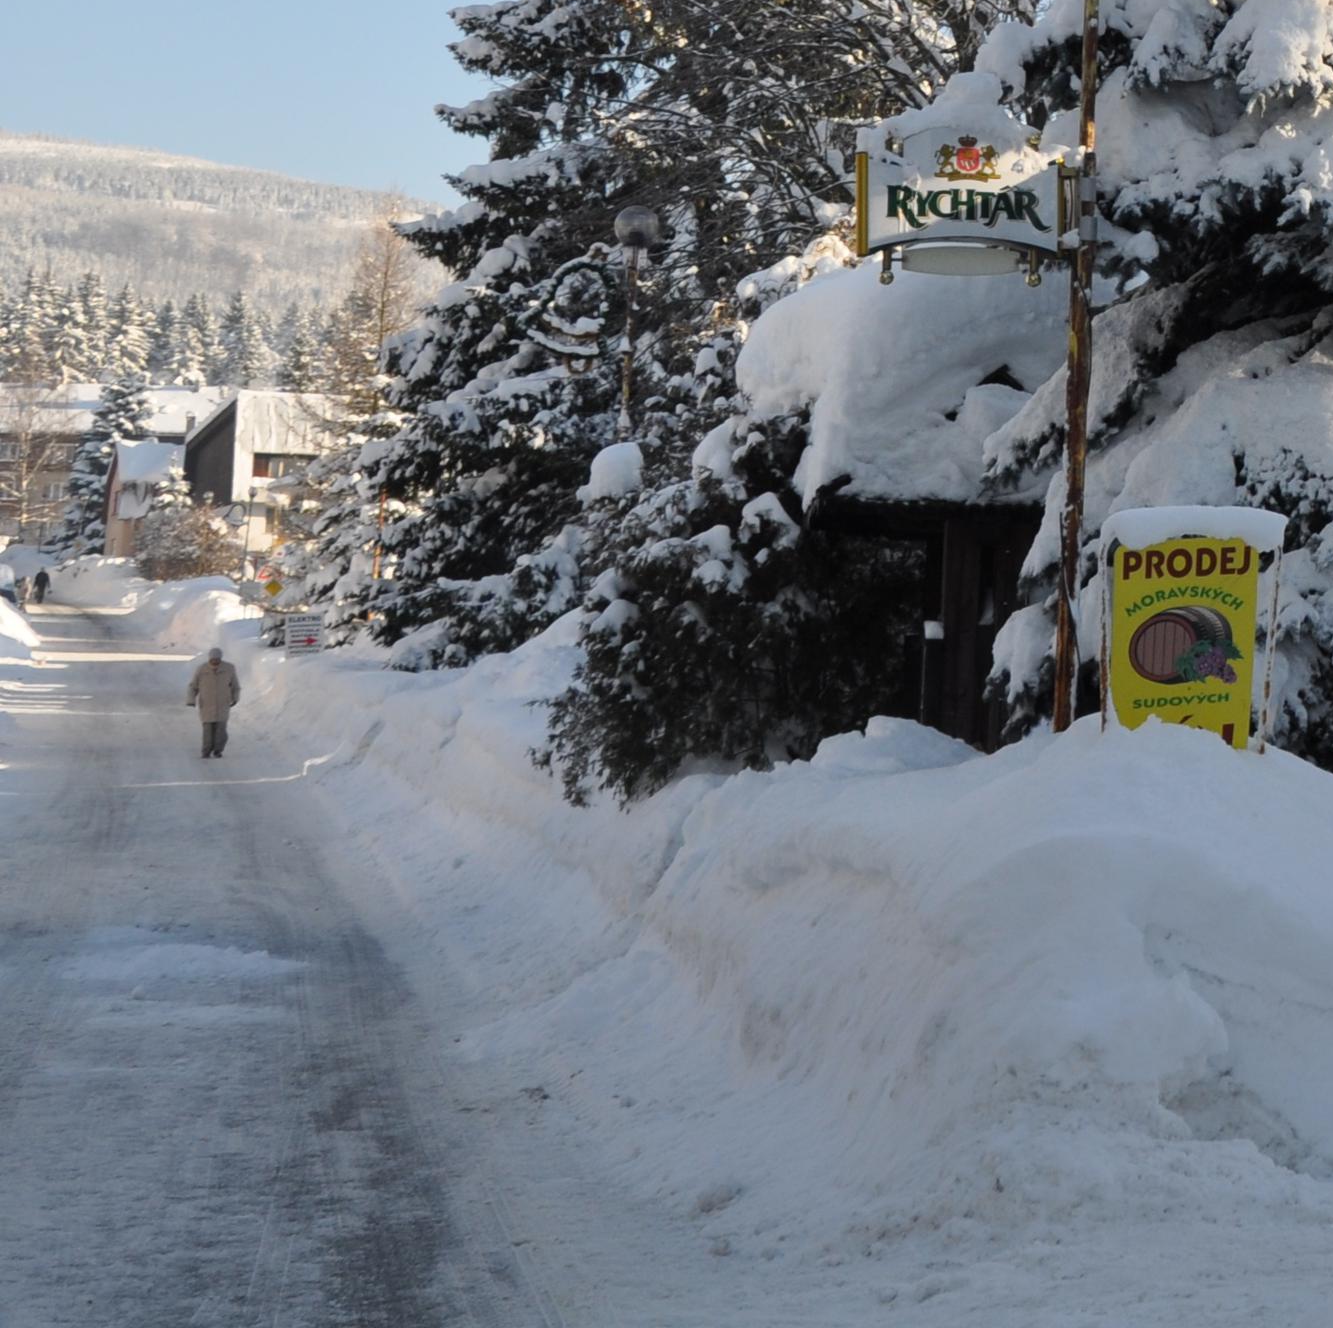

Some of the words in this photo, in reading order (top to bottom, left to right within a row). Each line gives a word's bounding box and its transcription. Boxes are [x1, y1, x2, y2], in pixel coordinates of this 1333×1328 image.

[1122, 546, 1252, 580] PRODEJ
[1125, 585, 1244, 618] MORAVSKÝCH
[1132, 691, 1230, 710] SUDOVÝCH
